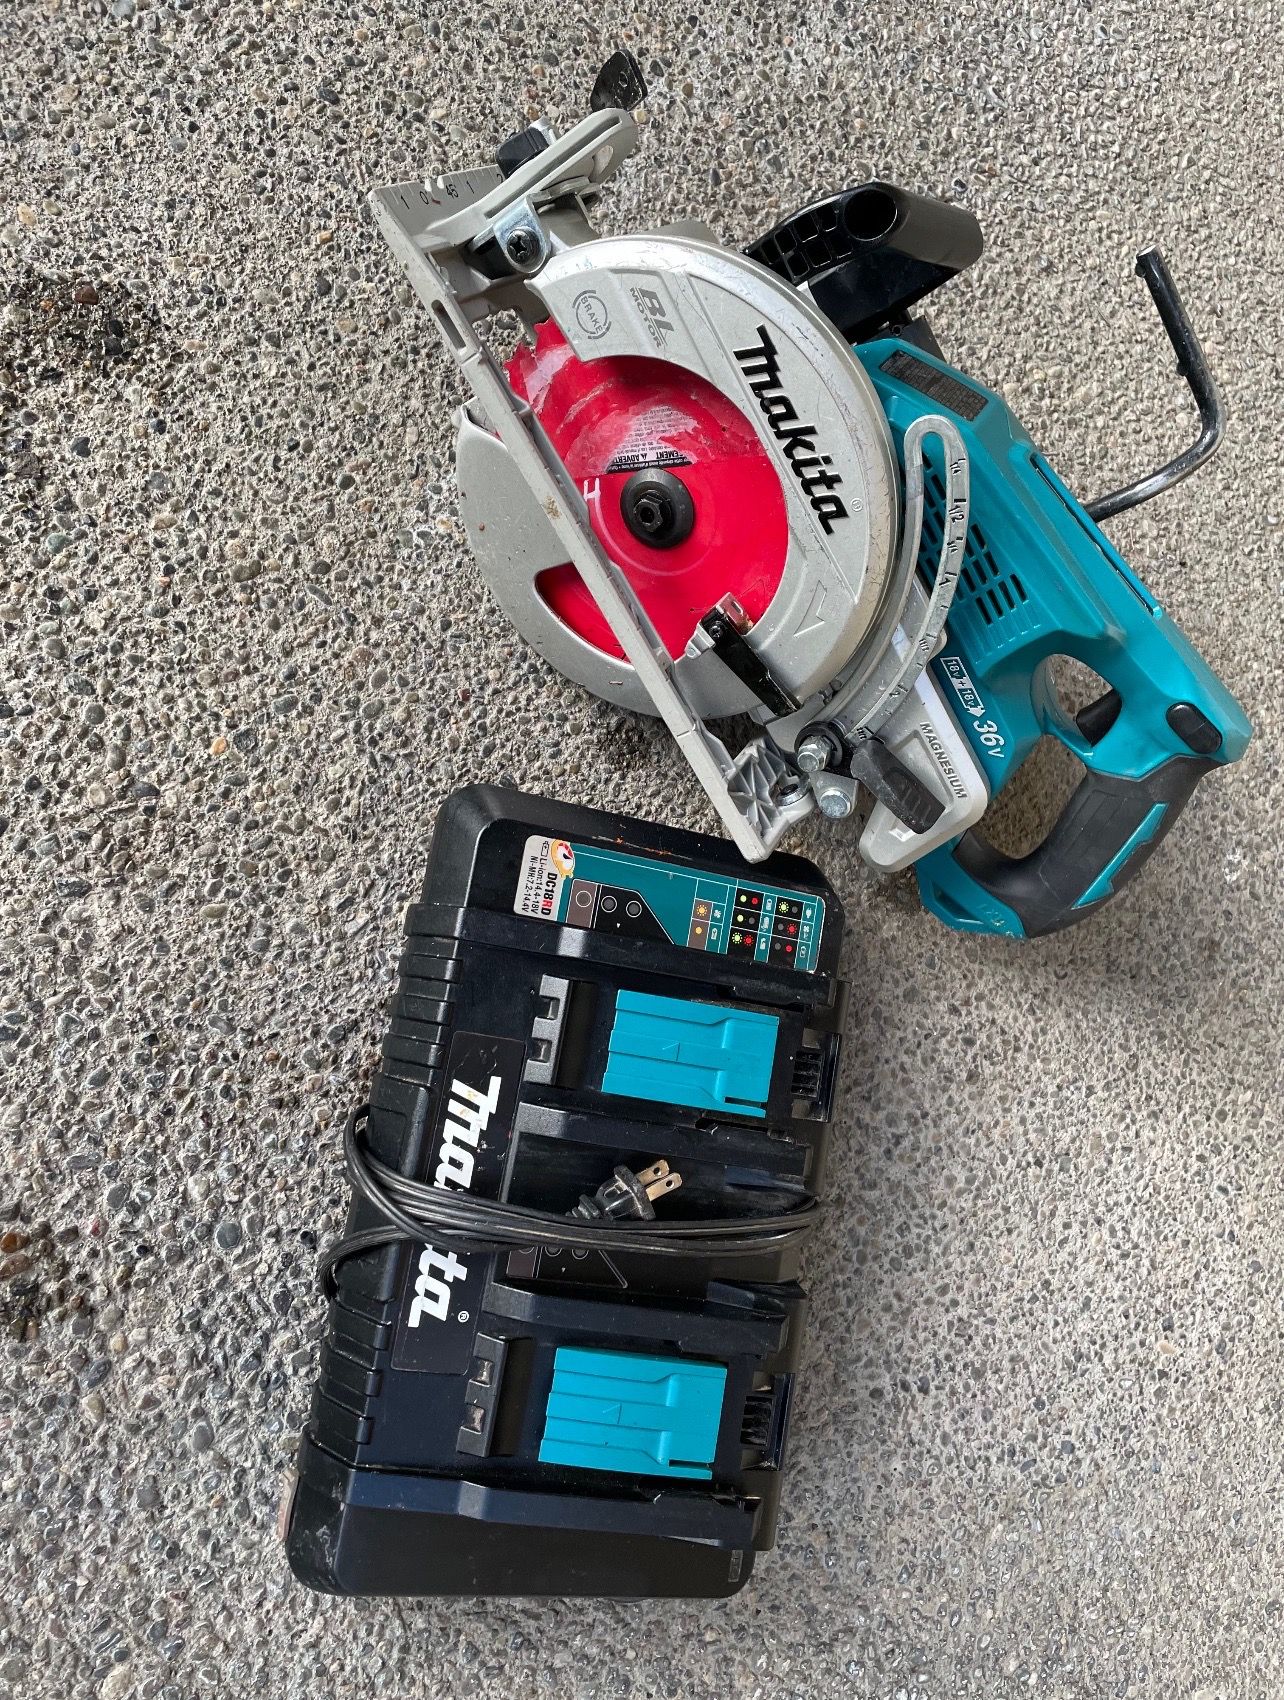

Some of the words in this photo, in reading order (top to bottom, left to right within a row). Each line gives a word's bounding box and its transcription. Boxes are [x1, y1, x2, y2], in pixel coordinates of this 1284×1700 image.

[580, 295, 603, 334] BRAKE
[629, 287, 662, 348] MOTOR
[655, 449, 684, 460] EMENT
[919, 721, 968, 799] MAGNESIUM
[540, 872, 558, 916] DC18RD
